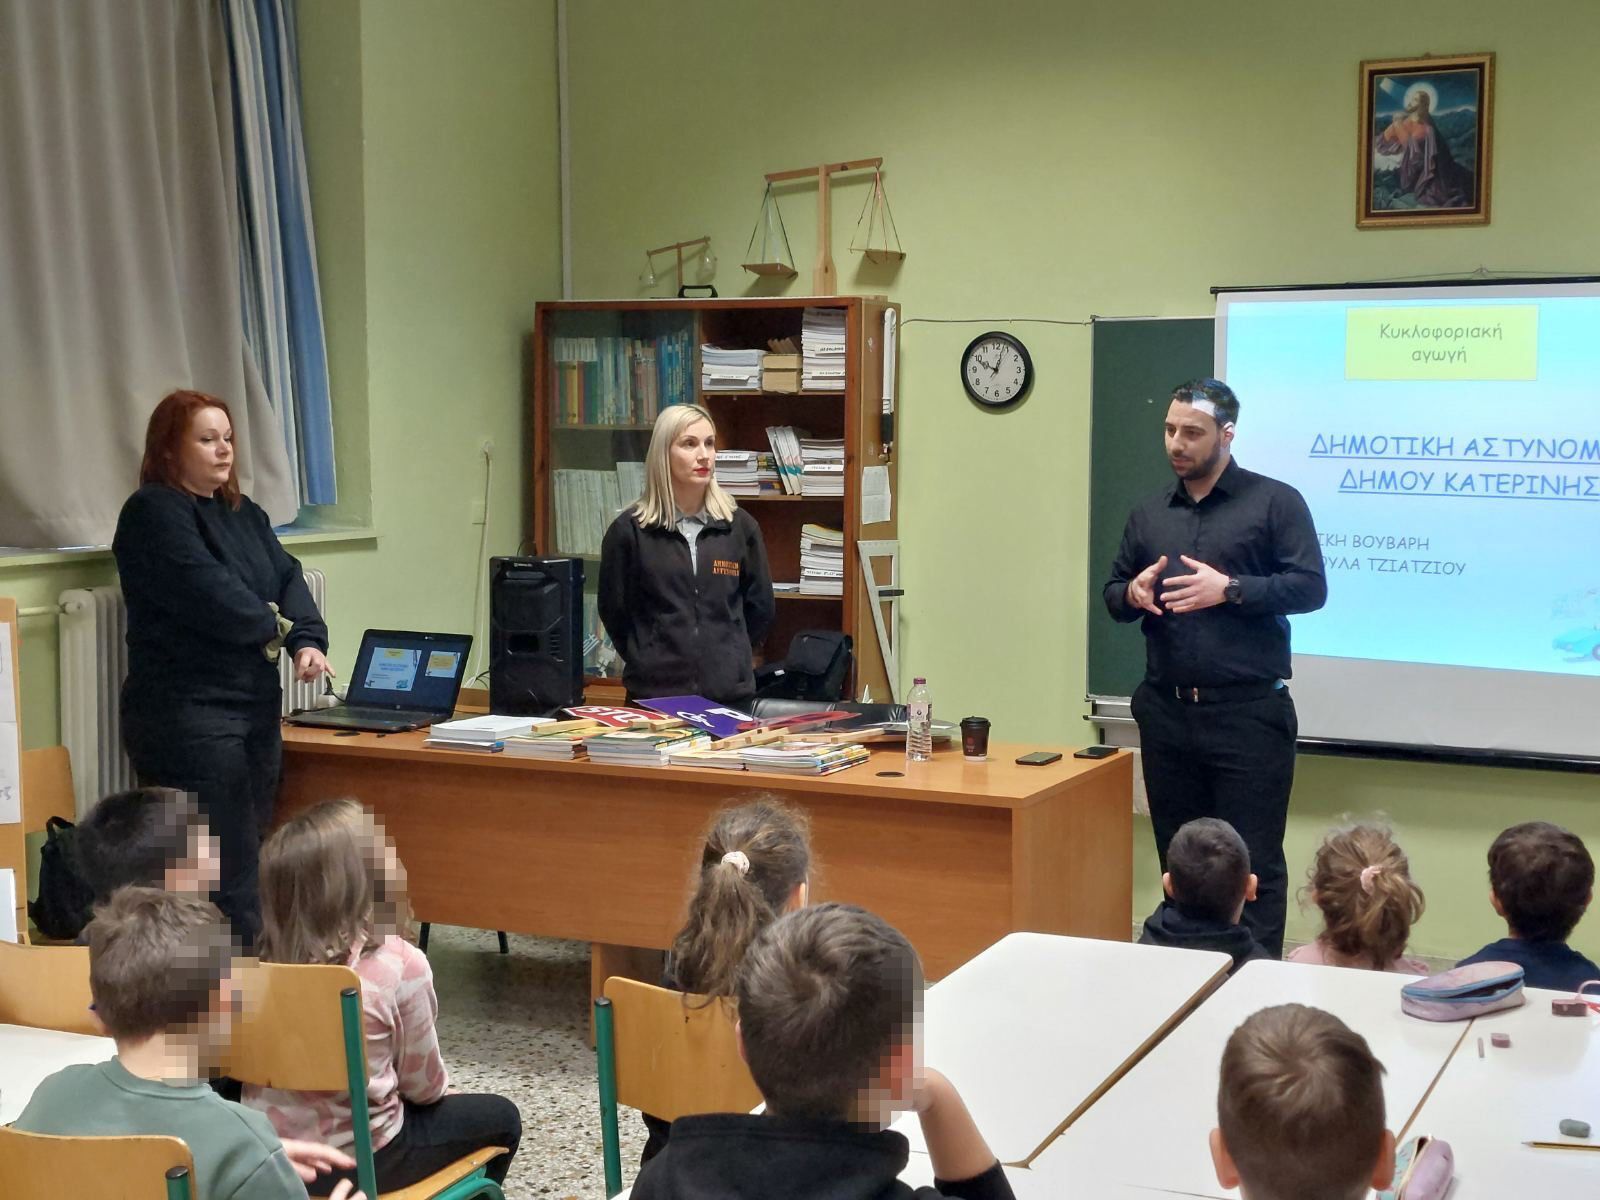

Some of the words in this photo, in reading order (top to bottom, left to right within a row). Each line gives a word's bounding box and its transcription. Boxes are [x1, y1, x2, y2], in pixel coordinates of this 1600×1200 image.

[1379, 322, 1503, 341] Κυκλοφοριακή
[1411, 346, 1467, 364] αγωγή
[1310, 433, 1454, 456] ΔΗΜΟΤΙΚΗ
[1463, 437, 1600, 460] ΑΣΤΥΝΟΜ
[1339, 468, 1435, 491] ΔΗΜΟΥ
[1444, 472, 1600, 496] ΚΑΤΕΡΙΝΗΣ
[1352, 534, 1430, 550] ΒΟΥΒΑΡΗ
[1367, 557, 1467, 576] ΤΖΙΑΤΖΙΟΥ
[576, 706, 649, 723] STO
